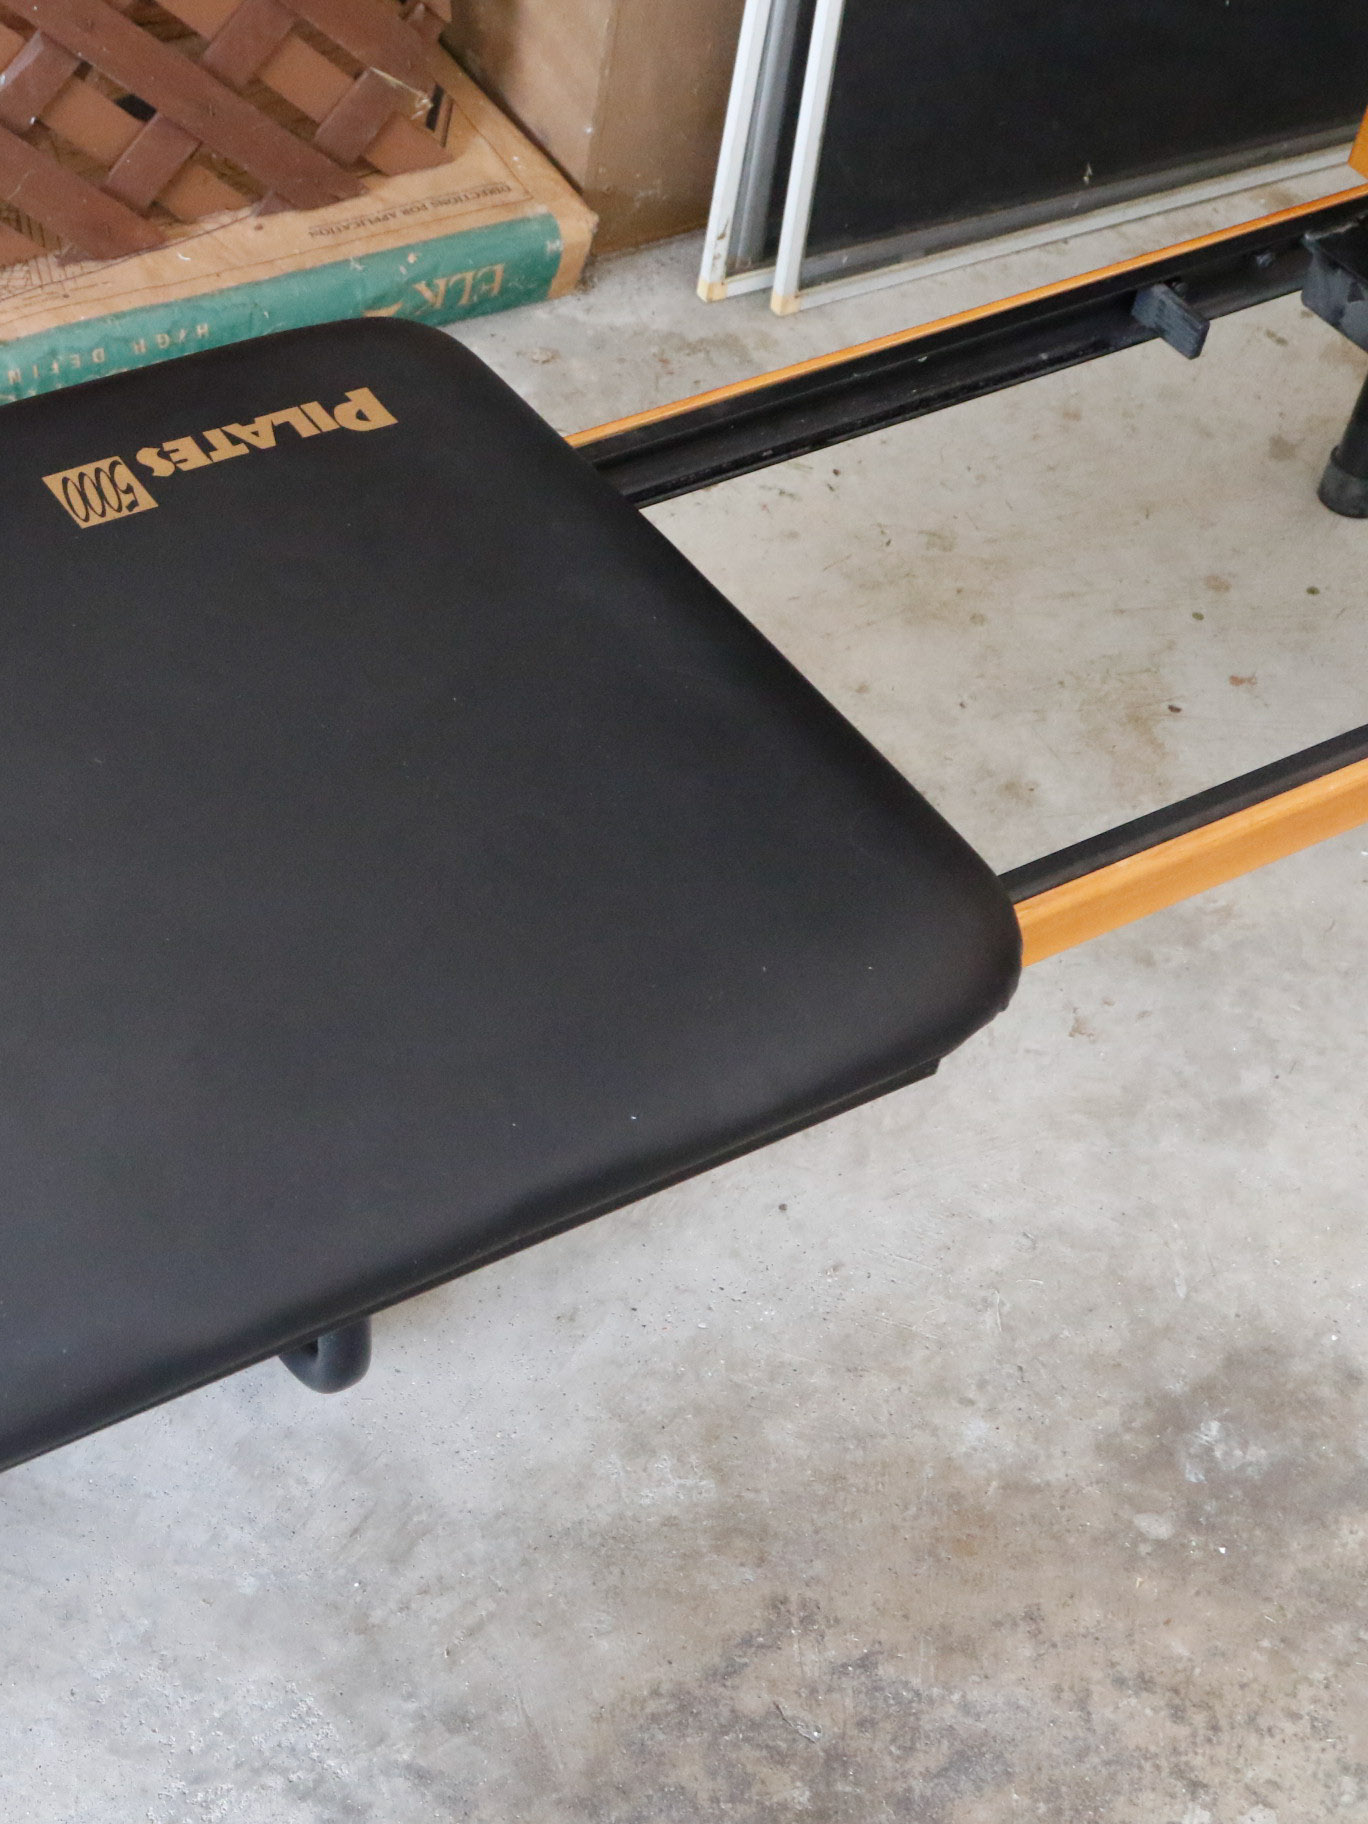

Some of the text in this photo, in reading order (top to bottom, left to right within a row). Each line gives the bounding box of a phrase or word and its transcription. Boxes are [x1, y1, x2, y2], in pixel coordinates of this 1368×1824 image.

[308, 183, 512, 239] DIRECTIONS FOR APPLICATION
[412, 263, 505, 310] ELK
[132, 323, 210, 355] HIGH
[135, 386, 399, 478] PILATES
[61, 459, 140, 524] 5000
